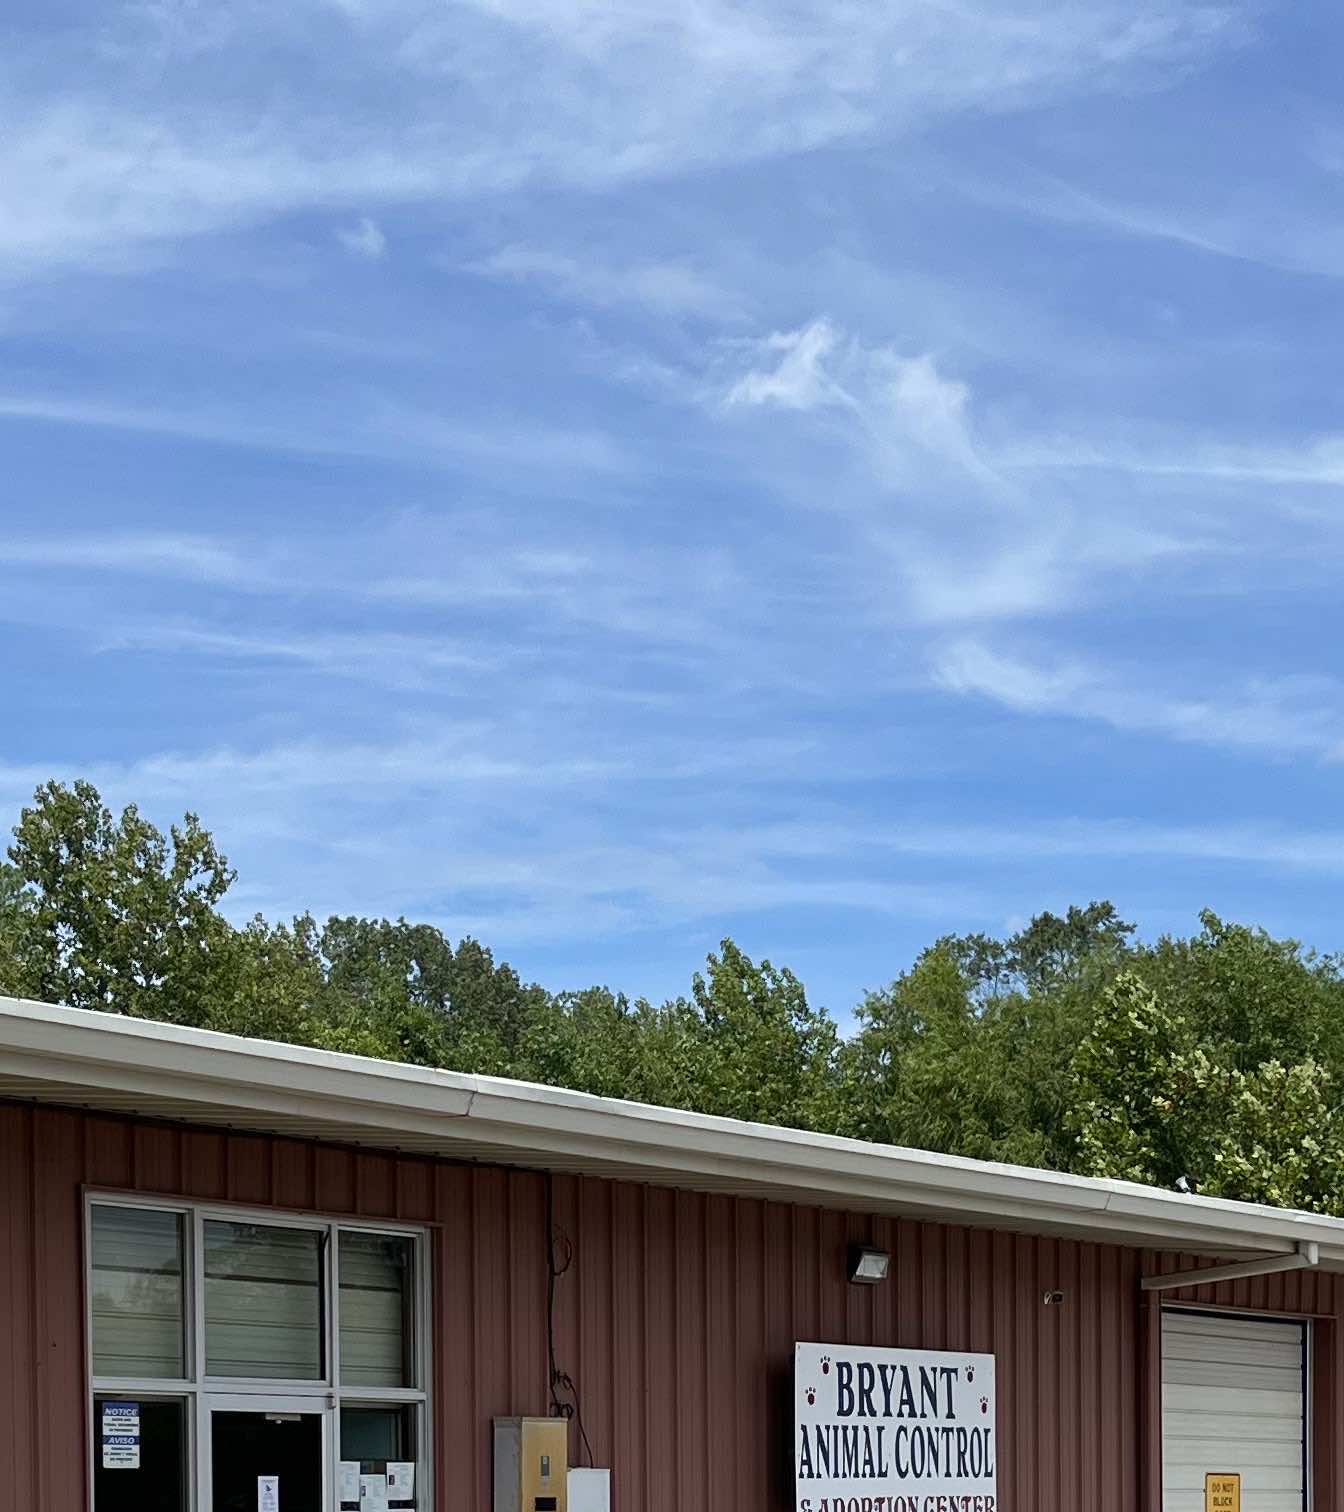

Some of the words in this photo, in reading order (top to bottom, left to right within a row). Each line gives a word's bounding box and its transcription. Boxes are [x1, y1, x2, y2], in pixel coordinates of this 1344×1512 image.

[836, 1361, 959, 1419] BRYANT
[105, 1408, 138, 1416] NOTICE
[799, 1424, 889, 1479] ANIMAL
[895, 1425, 994, 1479] CONTROL
[1212, 1483, 1221, 1493] DO
[1223, 1483, 1234, 1493] NOT
[1213, 1496, 1232, 1506] BLOCK
